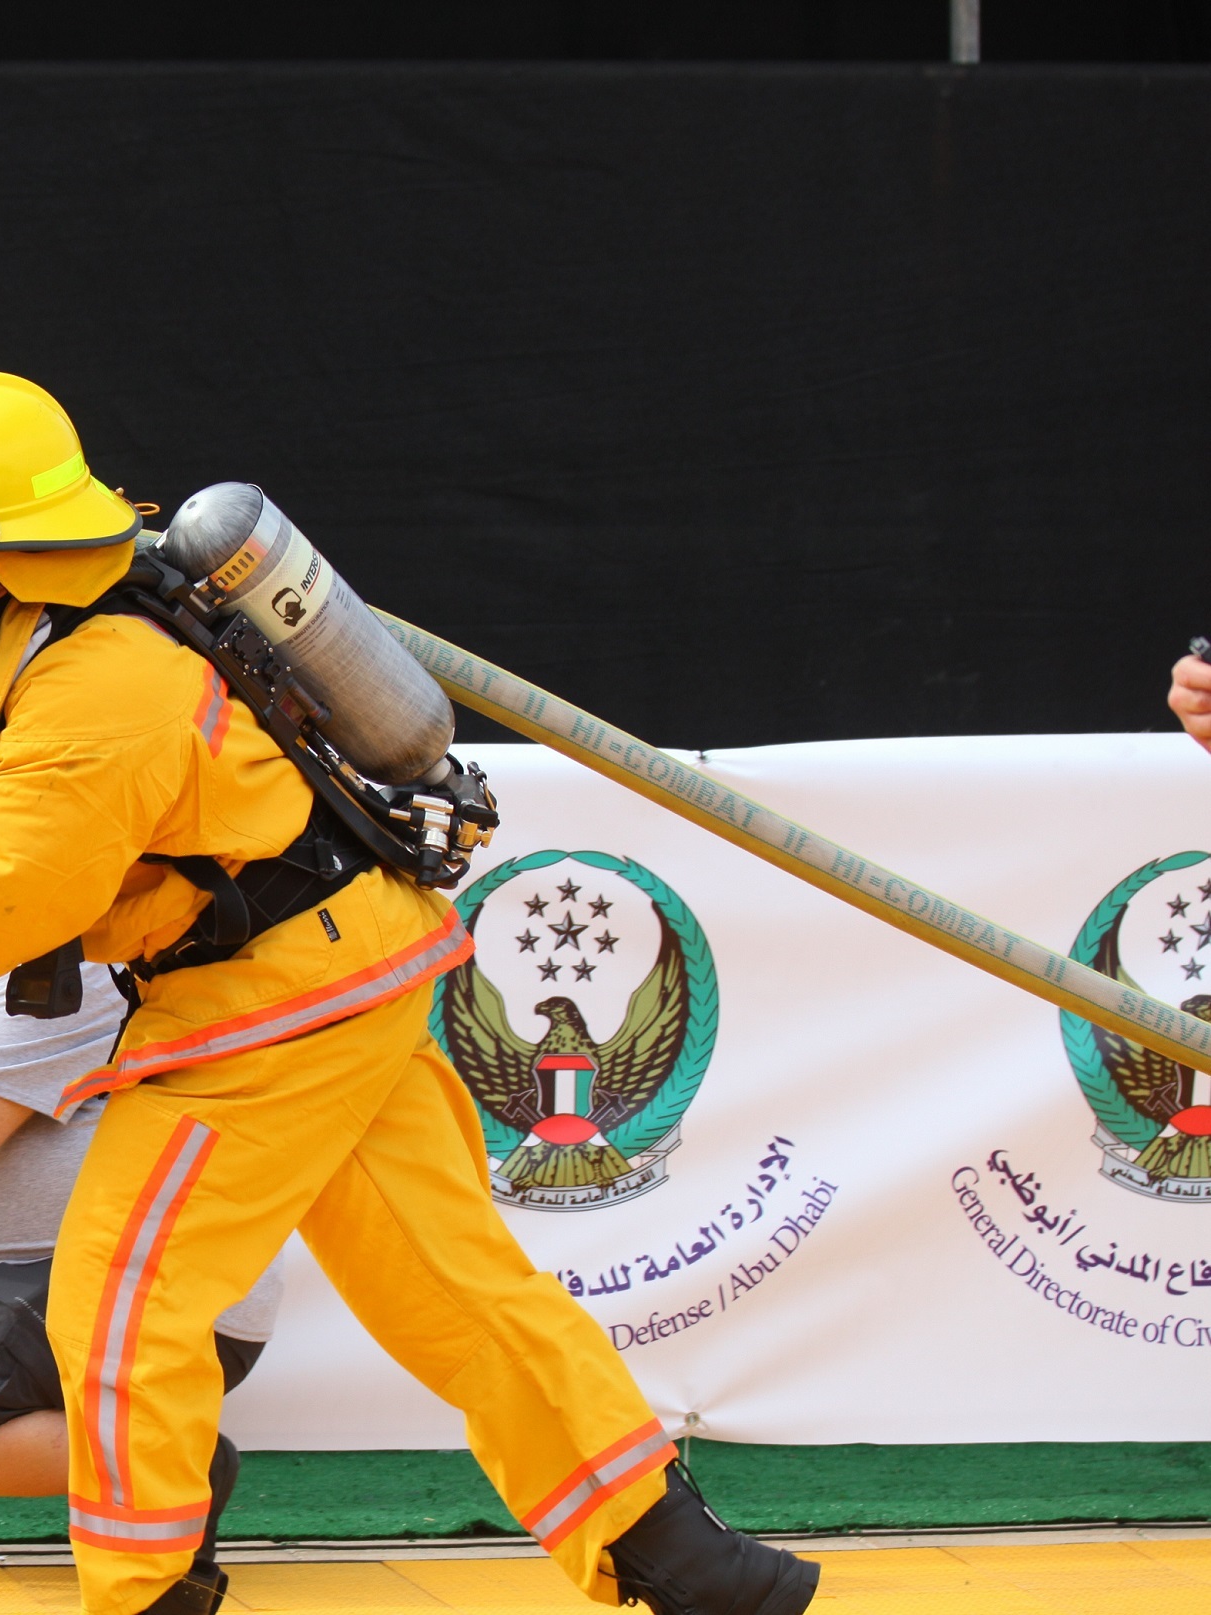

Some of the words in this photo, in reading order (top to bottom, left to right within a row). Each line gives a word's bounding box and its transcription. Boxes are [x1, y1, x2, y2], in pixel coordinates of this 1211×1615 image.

[388, 623, 499, 694] OMBAT
[1118, 990, 1210, 1049] SERVI
[720, 1135, 795, 1230] الإدارة
[608, 1299, 714, 1351] Defense
[730, 1252, 781, 1302] Abu
[768, 1176, 839, 1258] Dhabi
[635, 1221, 726, 1283] العامة
[951, 1165, 1020, 1260] General
[1006, 1244, 1139, 1338] Directorate
[1142, 1314, 1176, 1344] of
[1075, 1242, 1161, 1283] المدني
